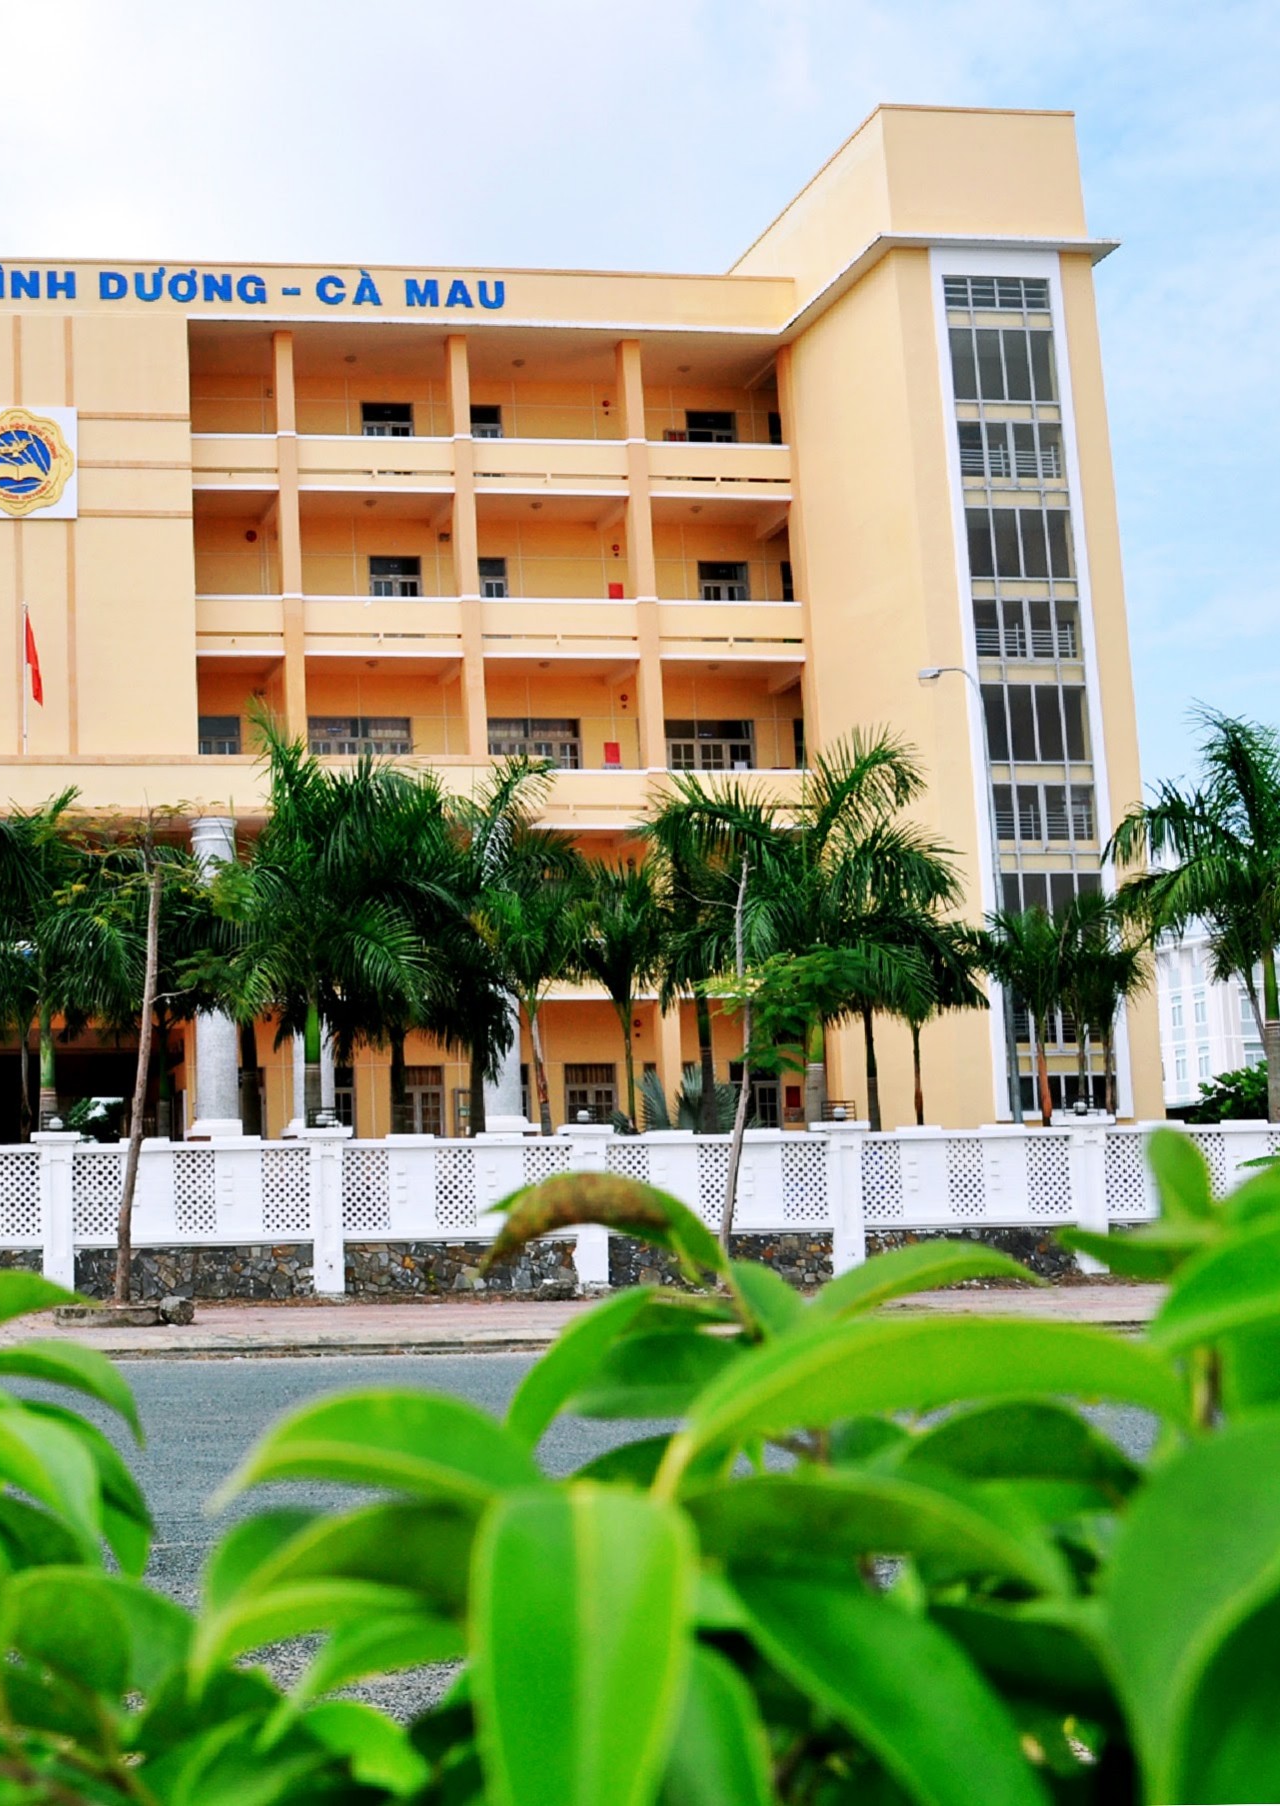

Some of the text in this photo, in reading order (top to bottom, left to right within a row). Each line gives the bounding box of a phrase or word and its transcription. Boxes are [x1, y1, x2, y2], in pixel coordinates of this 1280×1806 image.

[99, 267, 266, 303] DƯƠNG
[281, 287, 301, 296] -
[316, 270, 382, 305] CÀ
[405, 279, 505, 309] MAU
